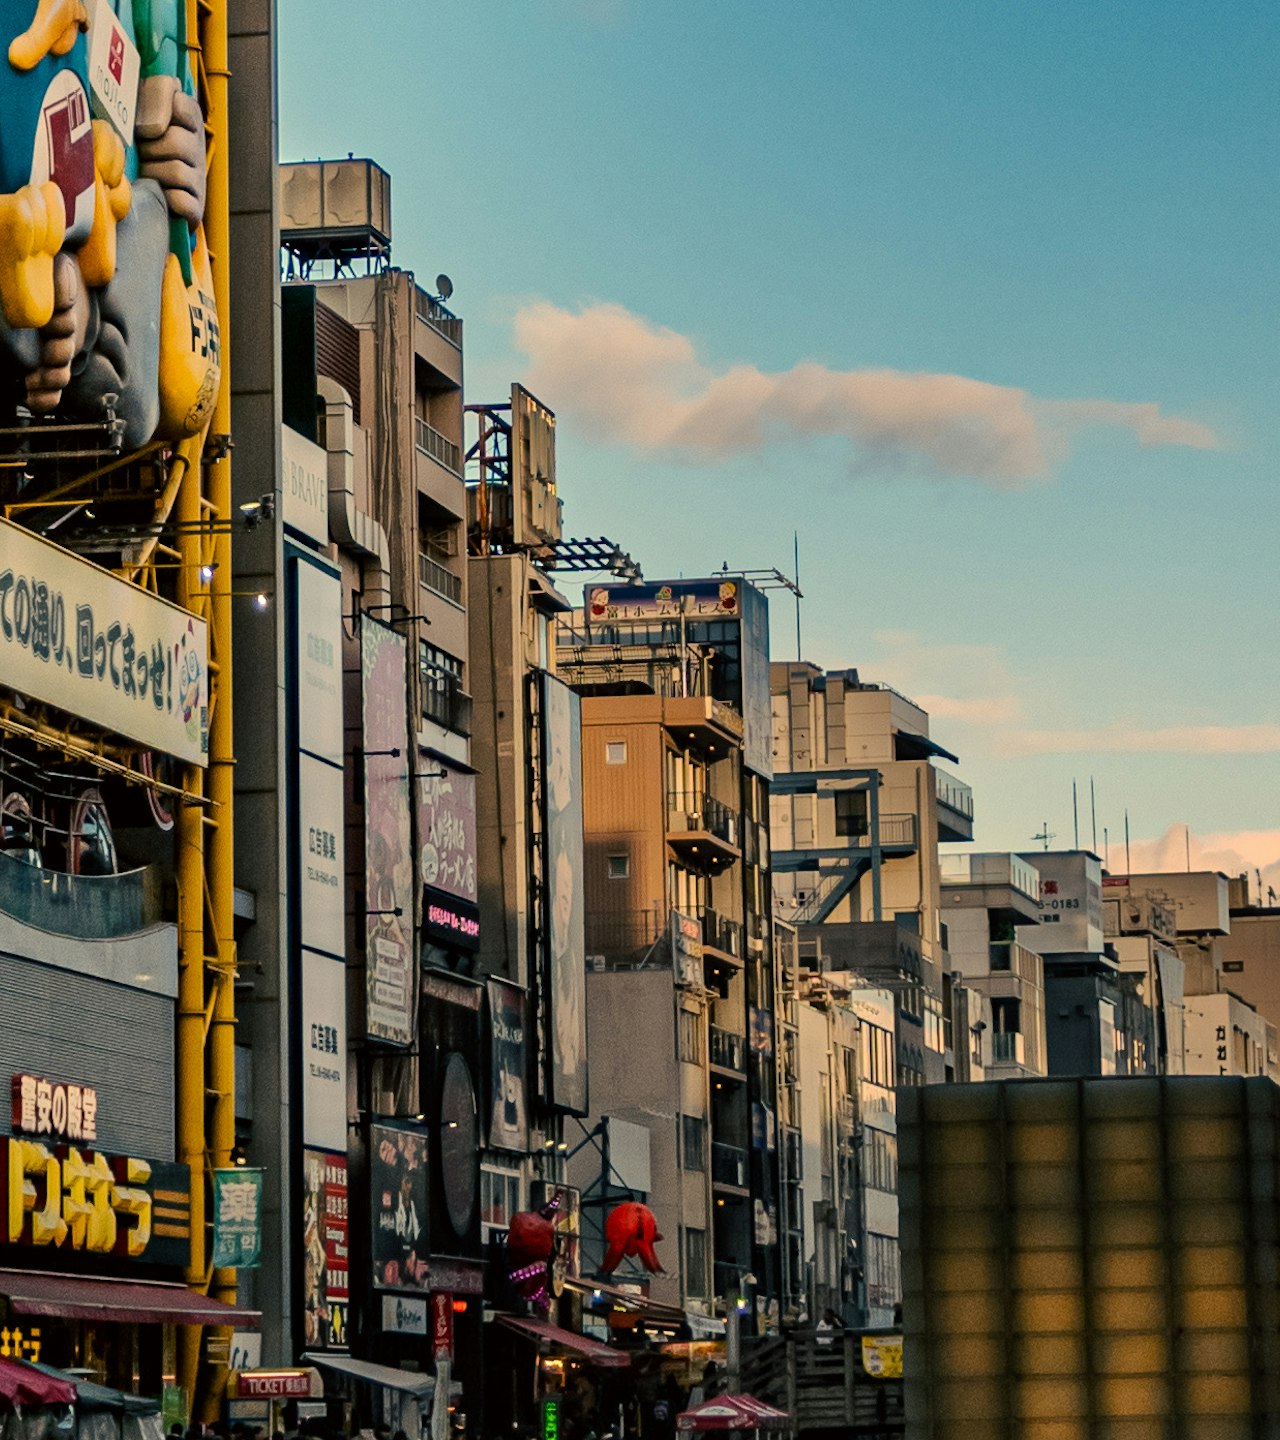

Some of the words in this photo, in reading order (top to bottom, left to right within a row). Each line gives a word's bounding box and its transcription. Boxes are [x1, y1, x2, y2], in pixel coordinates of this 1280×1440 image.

[291, 462, 326, 513] BRAVE
[606, 604, 720, 620] 富士ホームサビス
[220, 1182, 258, 1222] 薬
[248, 1378, 287, 1394] TICKET
